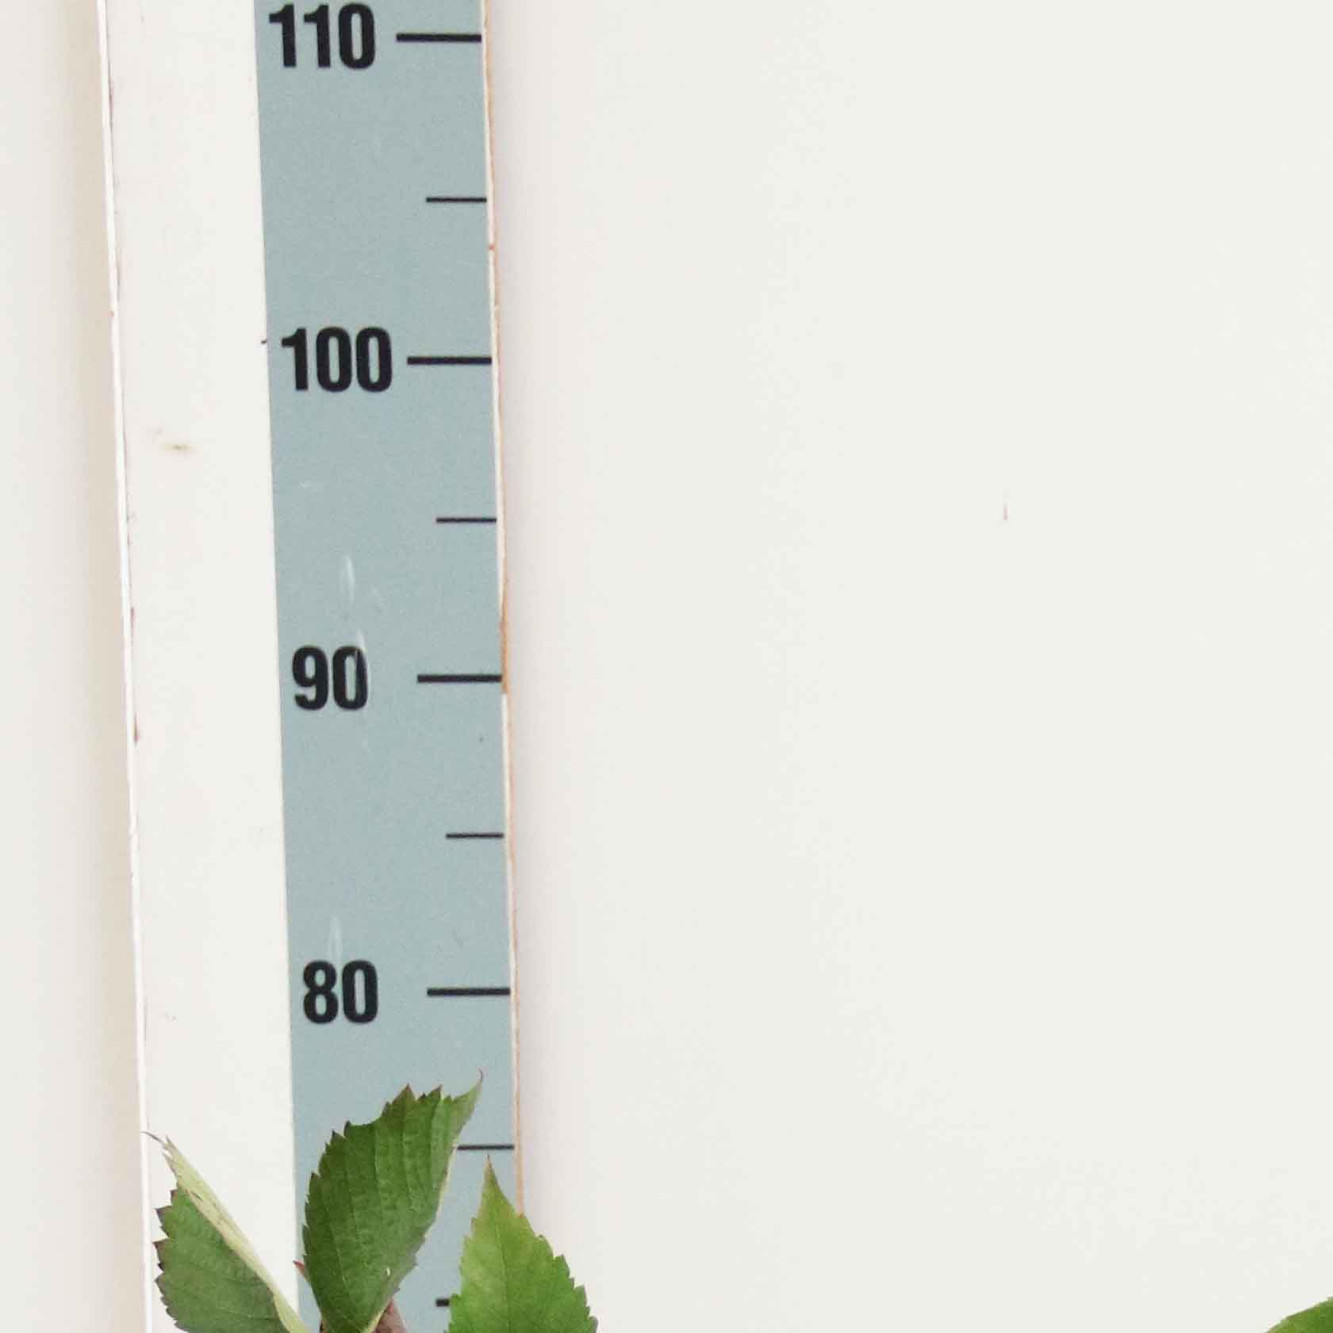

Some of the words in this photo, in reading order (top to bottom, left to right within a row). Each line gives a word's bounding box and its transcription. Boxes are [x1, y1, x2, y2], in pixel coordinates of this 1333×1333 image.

[269, 3, 375, 69] 110
[281, 327, 393, 393] 100
[292, 646, 368, 710] 90
[302, 960, 378, 1024] 80
